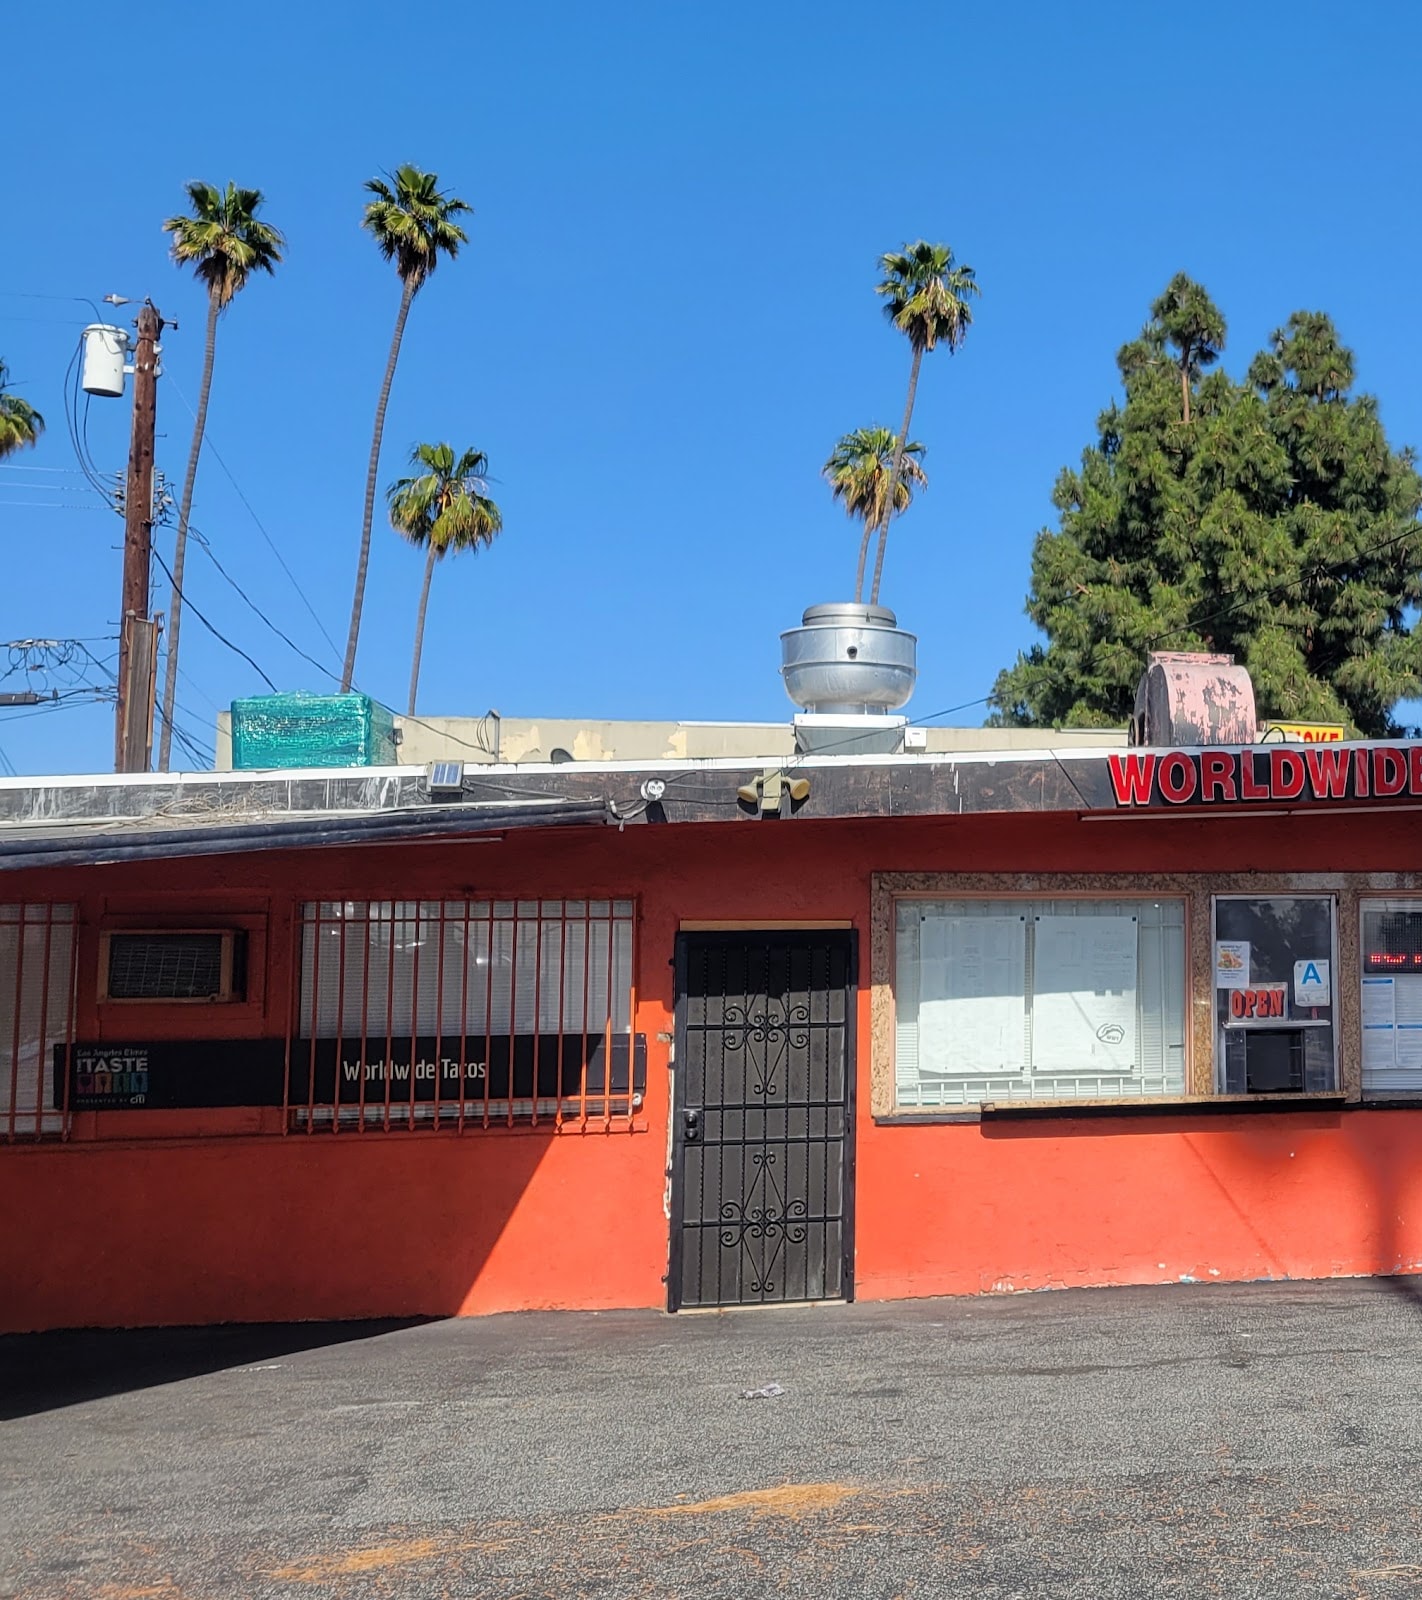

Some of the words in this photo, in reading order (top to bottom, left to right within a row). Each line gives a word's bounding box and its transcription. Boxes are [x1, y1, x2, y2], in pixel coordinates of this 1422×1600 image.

[1301, 962, 1322, 984] A
[1232, 989, 1284, 1018] OPEN
[93, 1049, 122, 1058] Angeles
[82, 1057, 148, 1073] TASTE
[441, 1058, 487, 1080] Tacos
